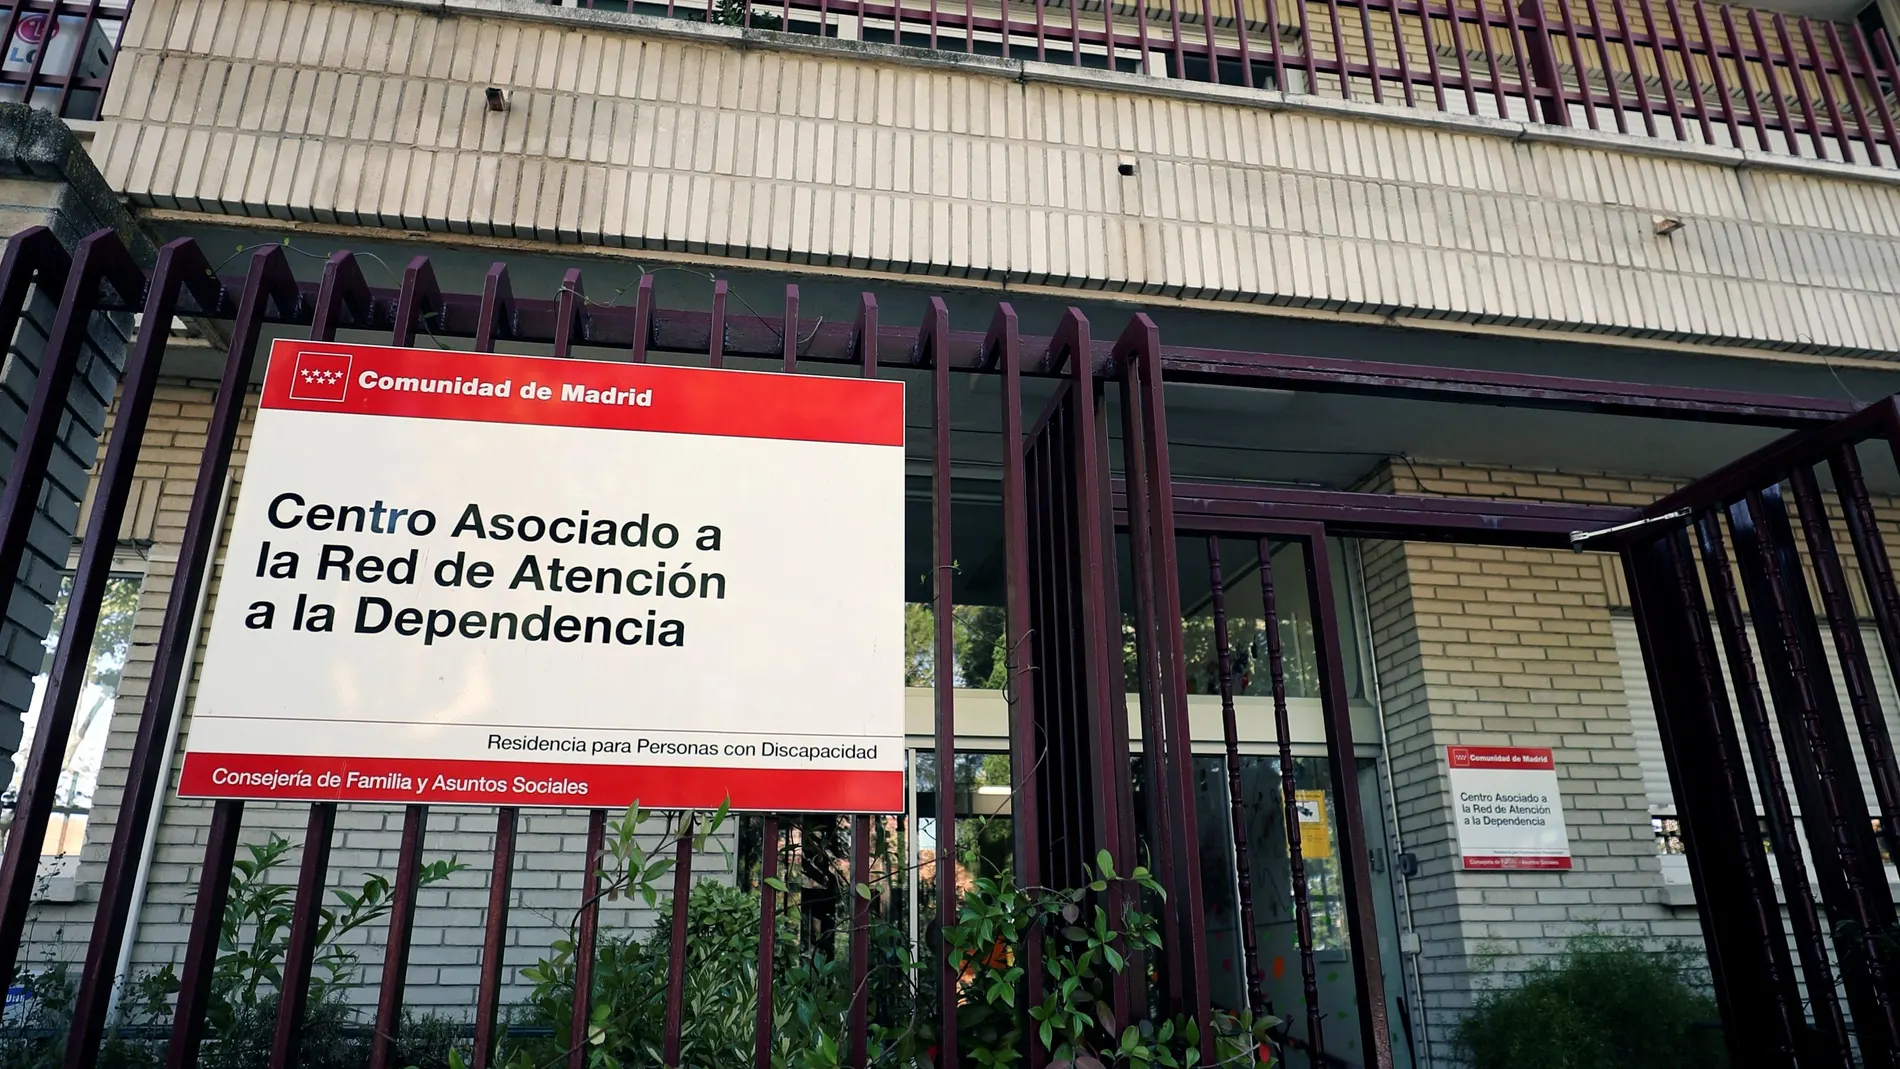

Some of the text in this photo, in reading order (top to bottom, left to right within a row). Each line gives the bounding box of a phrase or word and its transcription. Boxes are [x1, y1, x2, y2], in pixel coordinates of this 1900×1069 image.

[358, 370, 653, 407] Comunidad de Madrid
[267, 492, 722, 551] Centro Asociado a
[255, 540, 726, 600] la Red de Atención
[244, 593, 685, 647] a la Dependencia
[487, 734, 877, 762] Residencia para Personas con Discapacidad
[1469, 754, 1548, 763] Comunidad de Madrid
[212, 767, 588, 795] Consejería de Familia y Asuntos Sociales
[1460, 792, 1548, 803] Centro Asociado a
[1462, 804, 1551, 814] la Red de Atención
[1464, 816, 1546, 827] a la Dependencia
